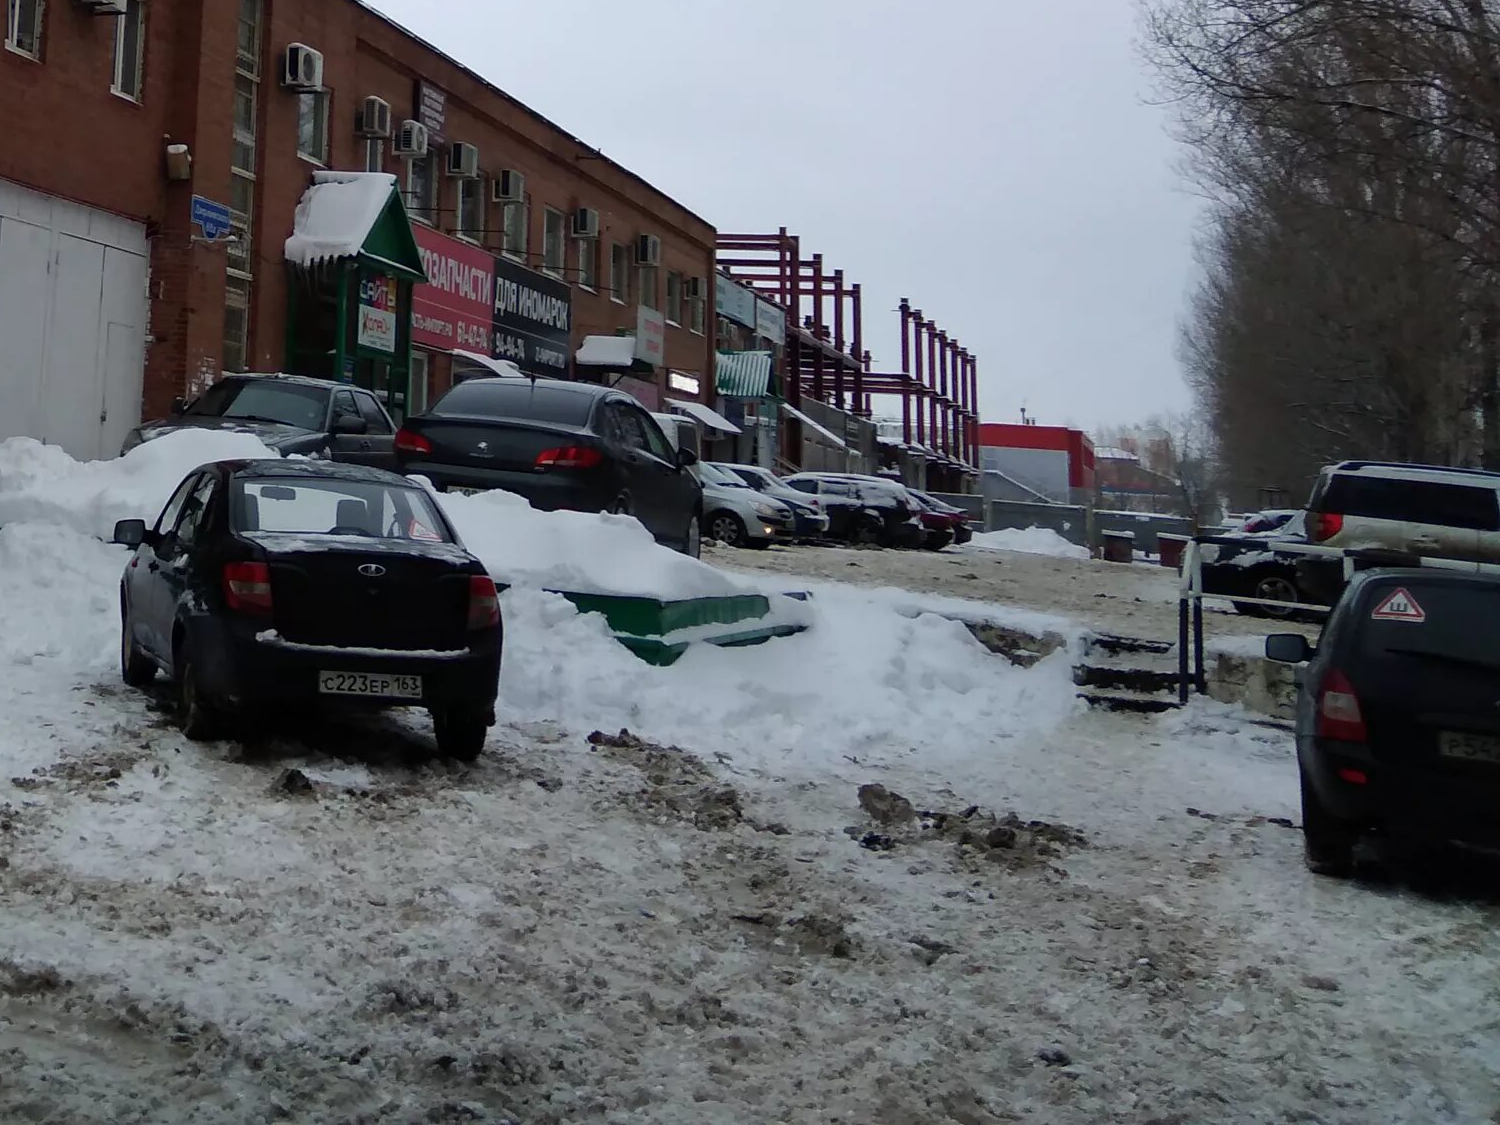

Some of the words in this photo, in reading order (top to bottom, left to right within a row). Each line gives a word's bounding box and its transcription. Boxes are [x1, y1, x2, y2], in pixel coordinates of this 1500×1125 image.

[417, 247, 492, 305] ТОЗАПЧАСТИ
[494, 277, 517, 316] ДЛЯ
[519, 285, 569, 331] ИНОМАРОК
[1390, 602, 1408, 612] Ш
[324, 674, 390, 693] С223ЕР
[394, 677, 419, 691] 163
